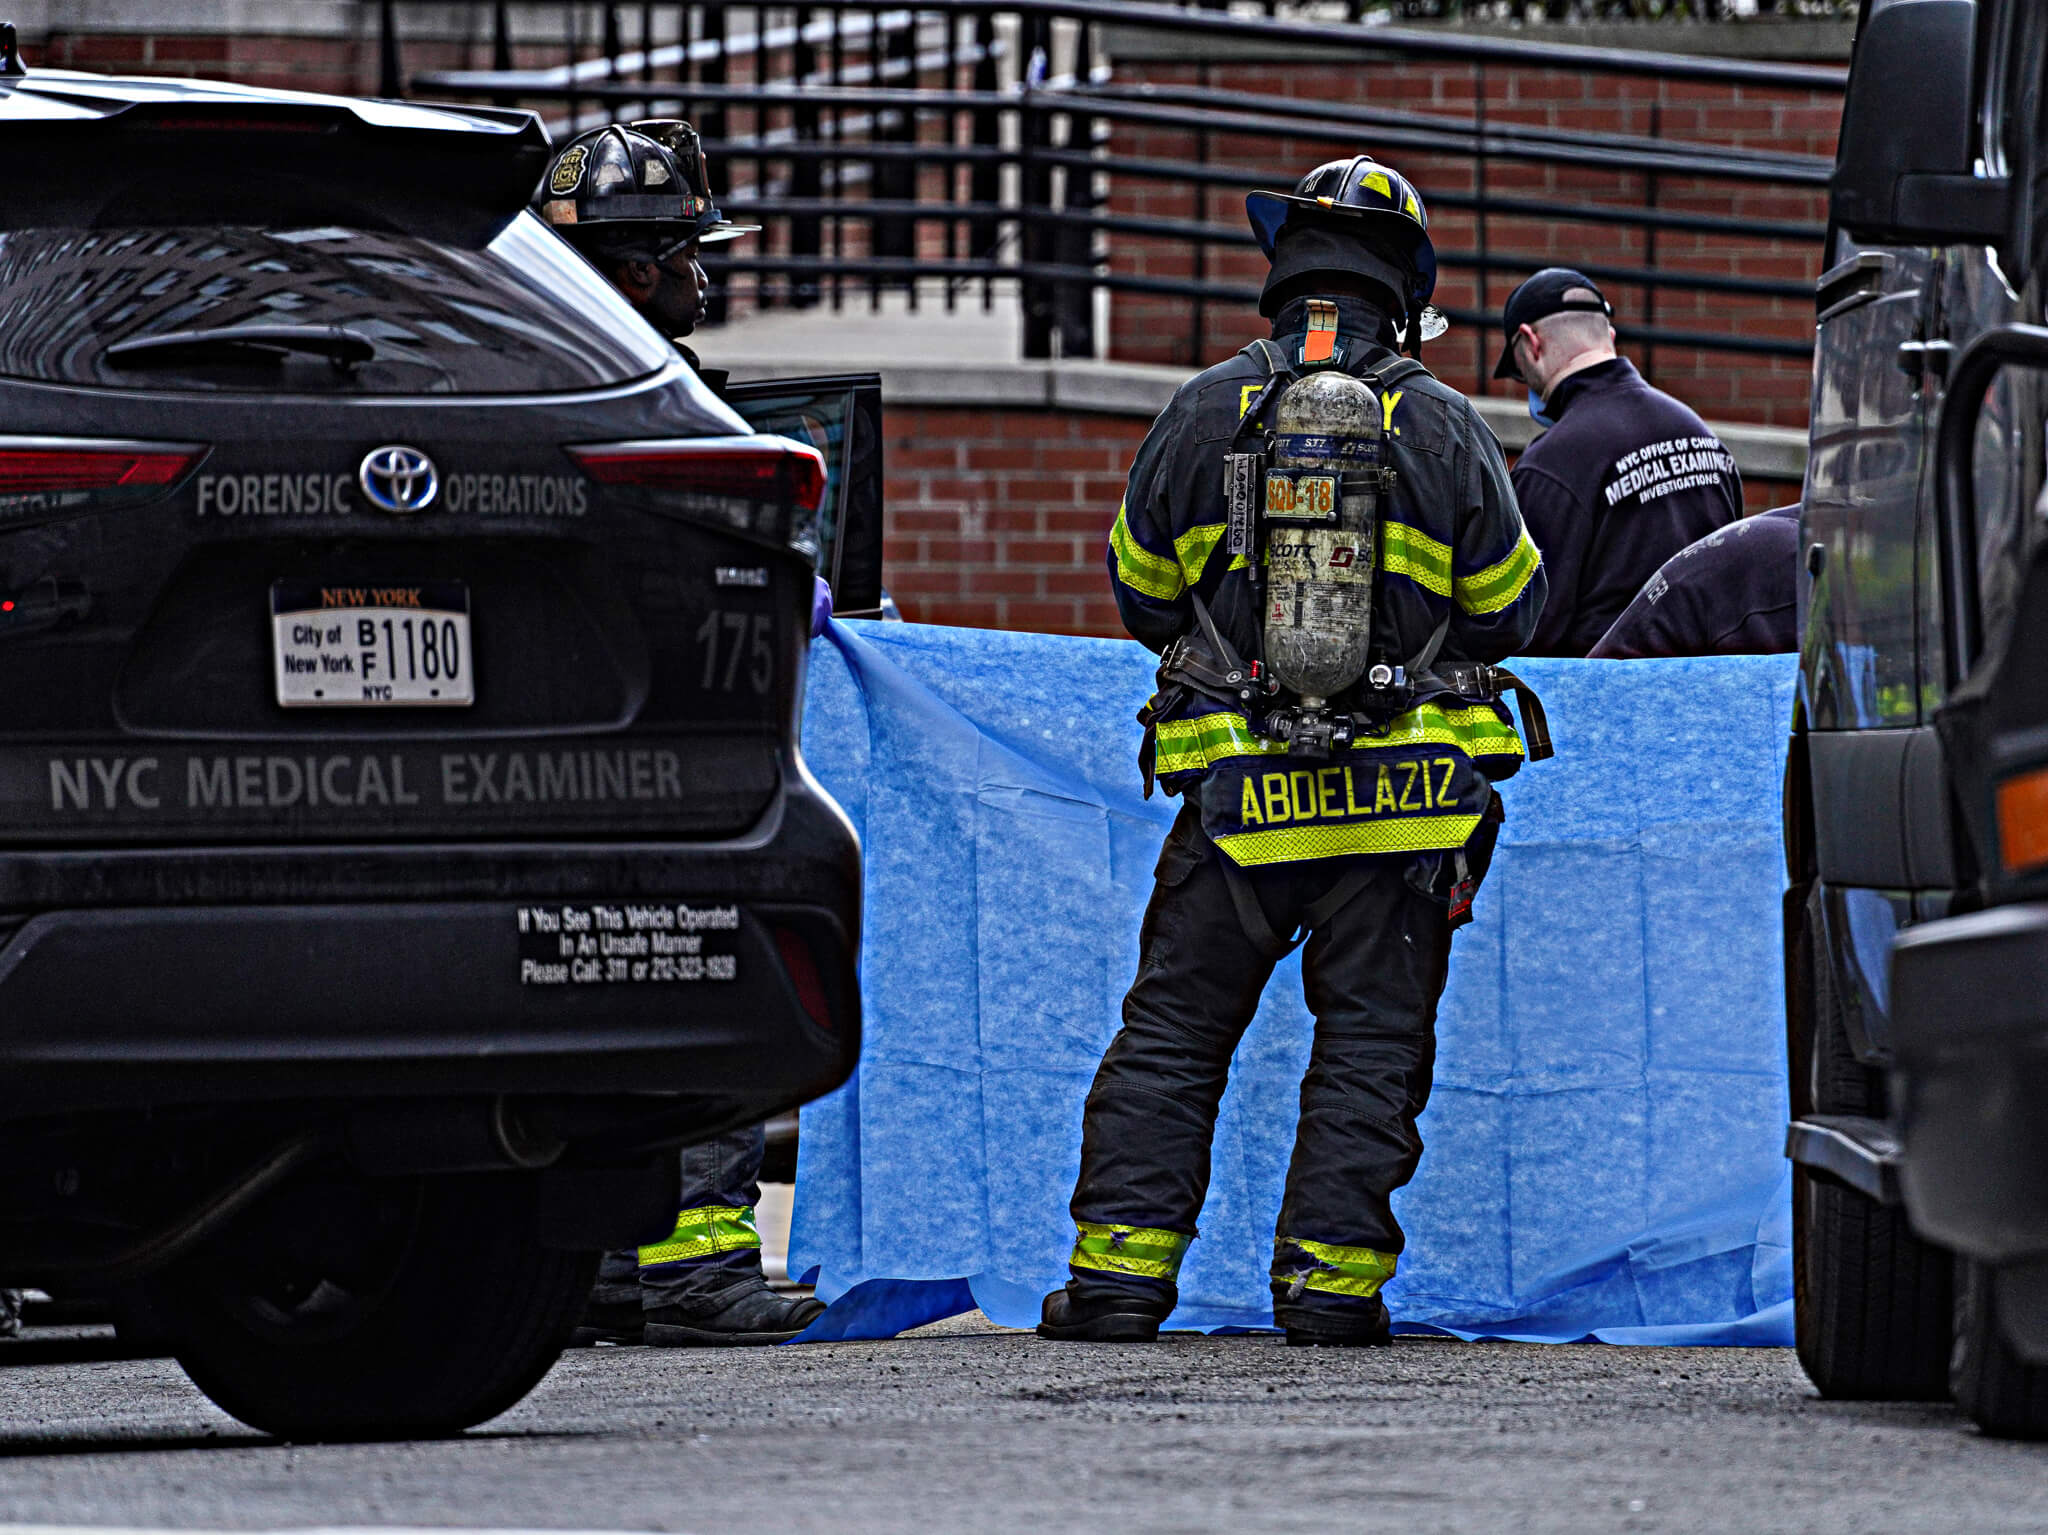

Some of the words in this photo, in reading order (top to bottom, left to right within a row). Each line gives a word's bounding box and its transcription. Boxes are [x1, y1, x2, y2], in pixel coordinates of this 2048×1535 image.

[1616, 451, 1640, 474] NYC
[1640, 440, 1674, 461] OFFICE
[1675, 438, 1688, 451] OF
[196, 474, 352, 515] FORENSIC
[445, 474, 588, 516] OPERATIONS
[1267, 480, 1332, 512] SQD-18
[1605, 459, 1670, 506] MEDICAL
[1639, 472, 1720, 505] INVESTIGATIONS
[321, 588, 367, 607] NEW
[372, 588, 421, 607] YORK
[293, 625, 323, 648] City
[326, 625, 342, 644] of
[358, 619, 377, 646] B
[284, 654, 317, 674] New
[320, 654, 355, 674] York
[382, 619, 459, 680] 1180
[696, 610, 773, 694] 175
[361, 652, 377, 680] F
[362, 686, 393, 700] NYC
[49, 757, 160, 810] NYC
[187, 755, 419, 808] MEDICAL
[442, 750, 683, 803] EXAMINER
[1241, 757, 1459, 825] ABDELAZIZ
[531, 908, 560, 931] You
[562, 907, 591, 931] See
[592, 906, 624, 930] This
[624, 905, 675, 929] Vehicle
[677, 904, 739, 931] Operated
[560, 933, 574, 956] In
[577, 933, 597, 956] An
[600, 932, 649, 955] Unsafe
[651, 931, 702, 954] Manner
[521, 959, 568, 983] Please
[632, 961, 649, 980] or
